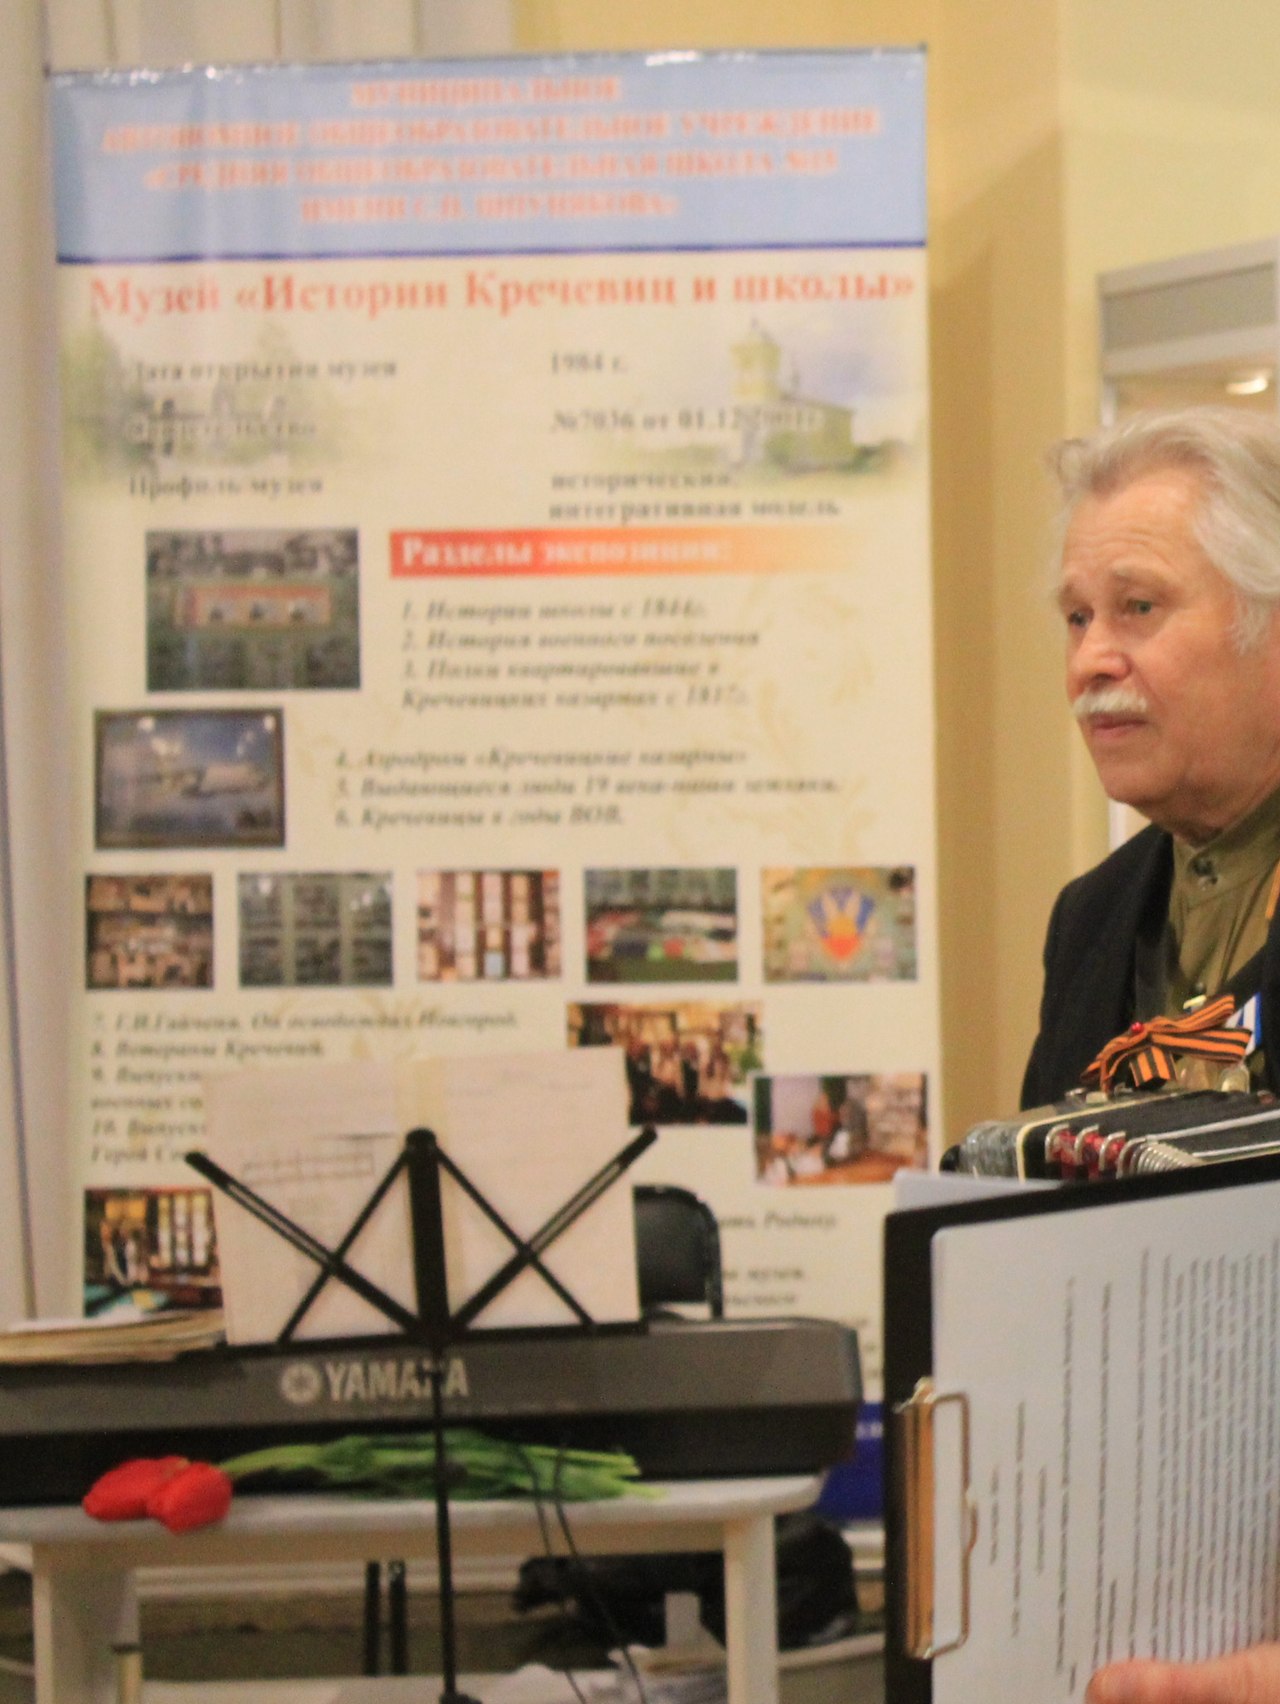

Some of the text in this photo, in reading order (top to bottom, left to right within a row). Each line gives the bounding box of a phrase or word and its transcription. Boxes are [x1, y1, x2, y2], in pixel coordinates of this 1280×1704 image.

[90, 270, 917, 324] Музей «Истории Кречевиц и школы»
[327, 359, 397, 381] музея
[250, 478, 324, 502] музея
[402, 535, 533, 568] Разделы
